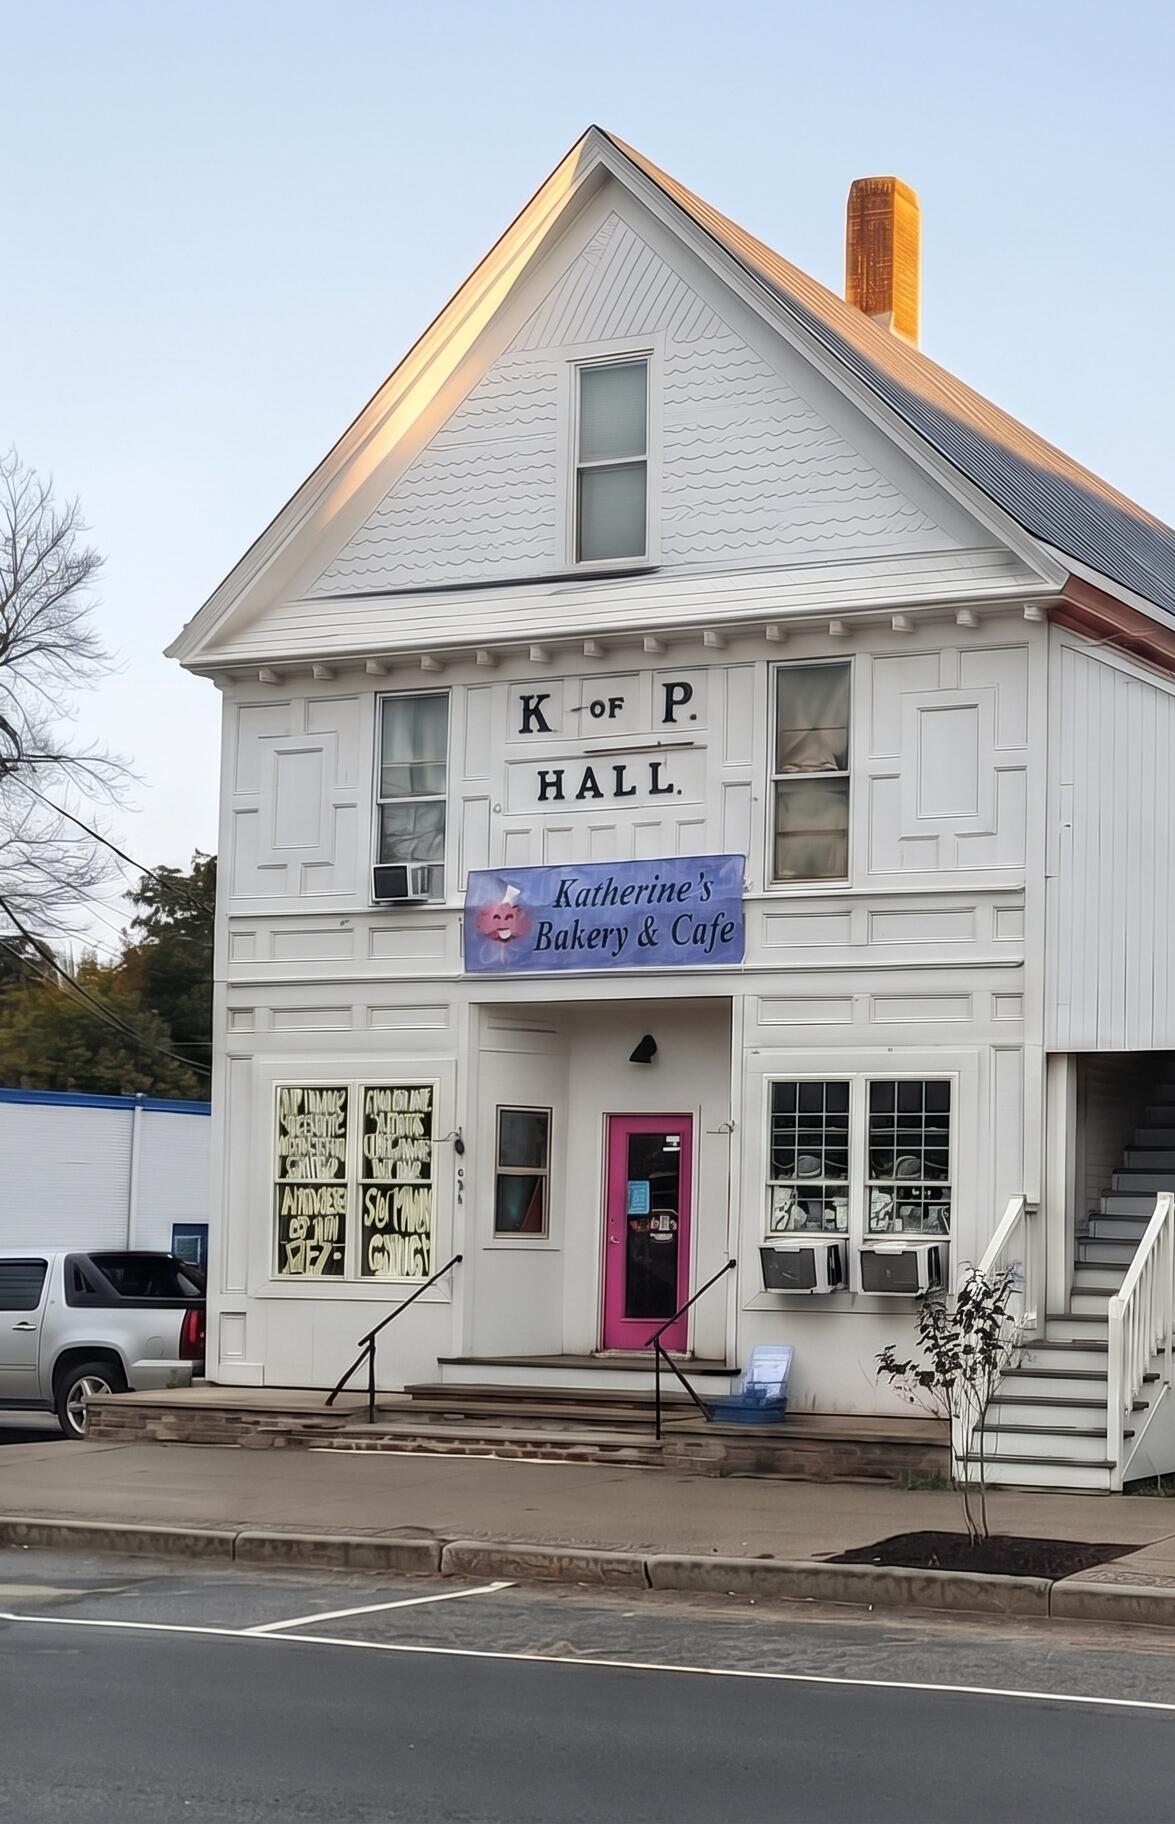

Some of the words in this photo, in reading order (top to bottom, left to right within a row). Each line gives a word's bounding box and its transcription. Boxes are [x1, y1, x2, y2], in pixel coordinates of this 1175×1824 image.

[518, 693, 551, 734] K
[589, 696, 625, 718] OF
[662, 681, 697, 724] P.
[537, 761, 682, 801] HALL.
[552, 872, 714, 909] Katherine's
[533, 918, 629, 957] Bakery
[637, 915, 659, 947] &
[671, 911, 735, 954] Cafe
